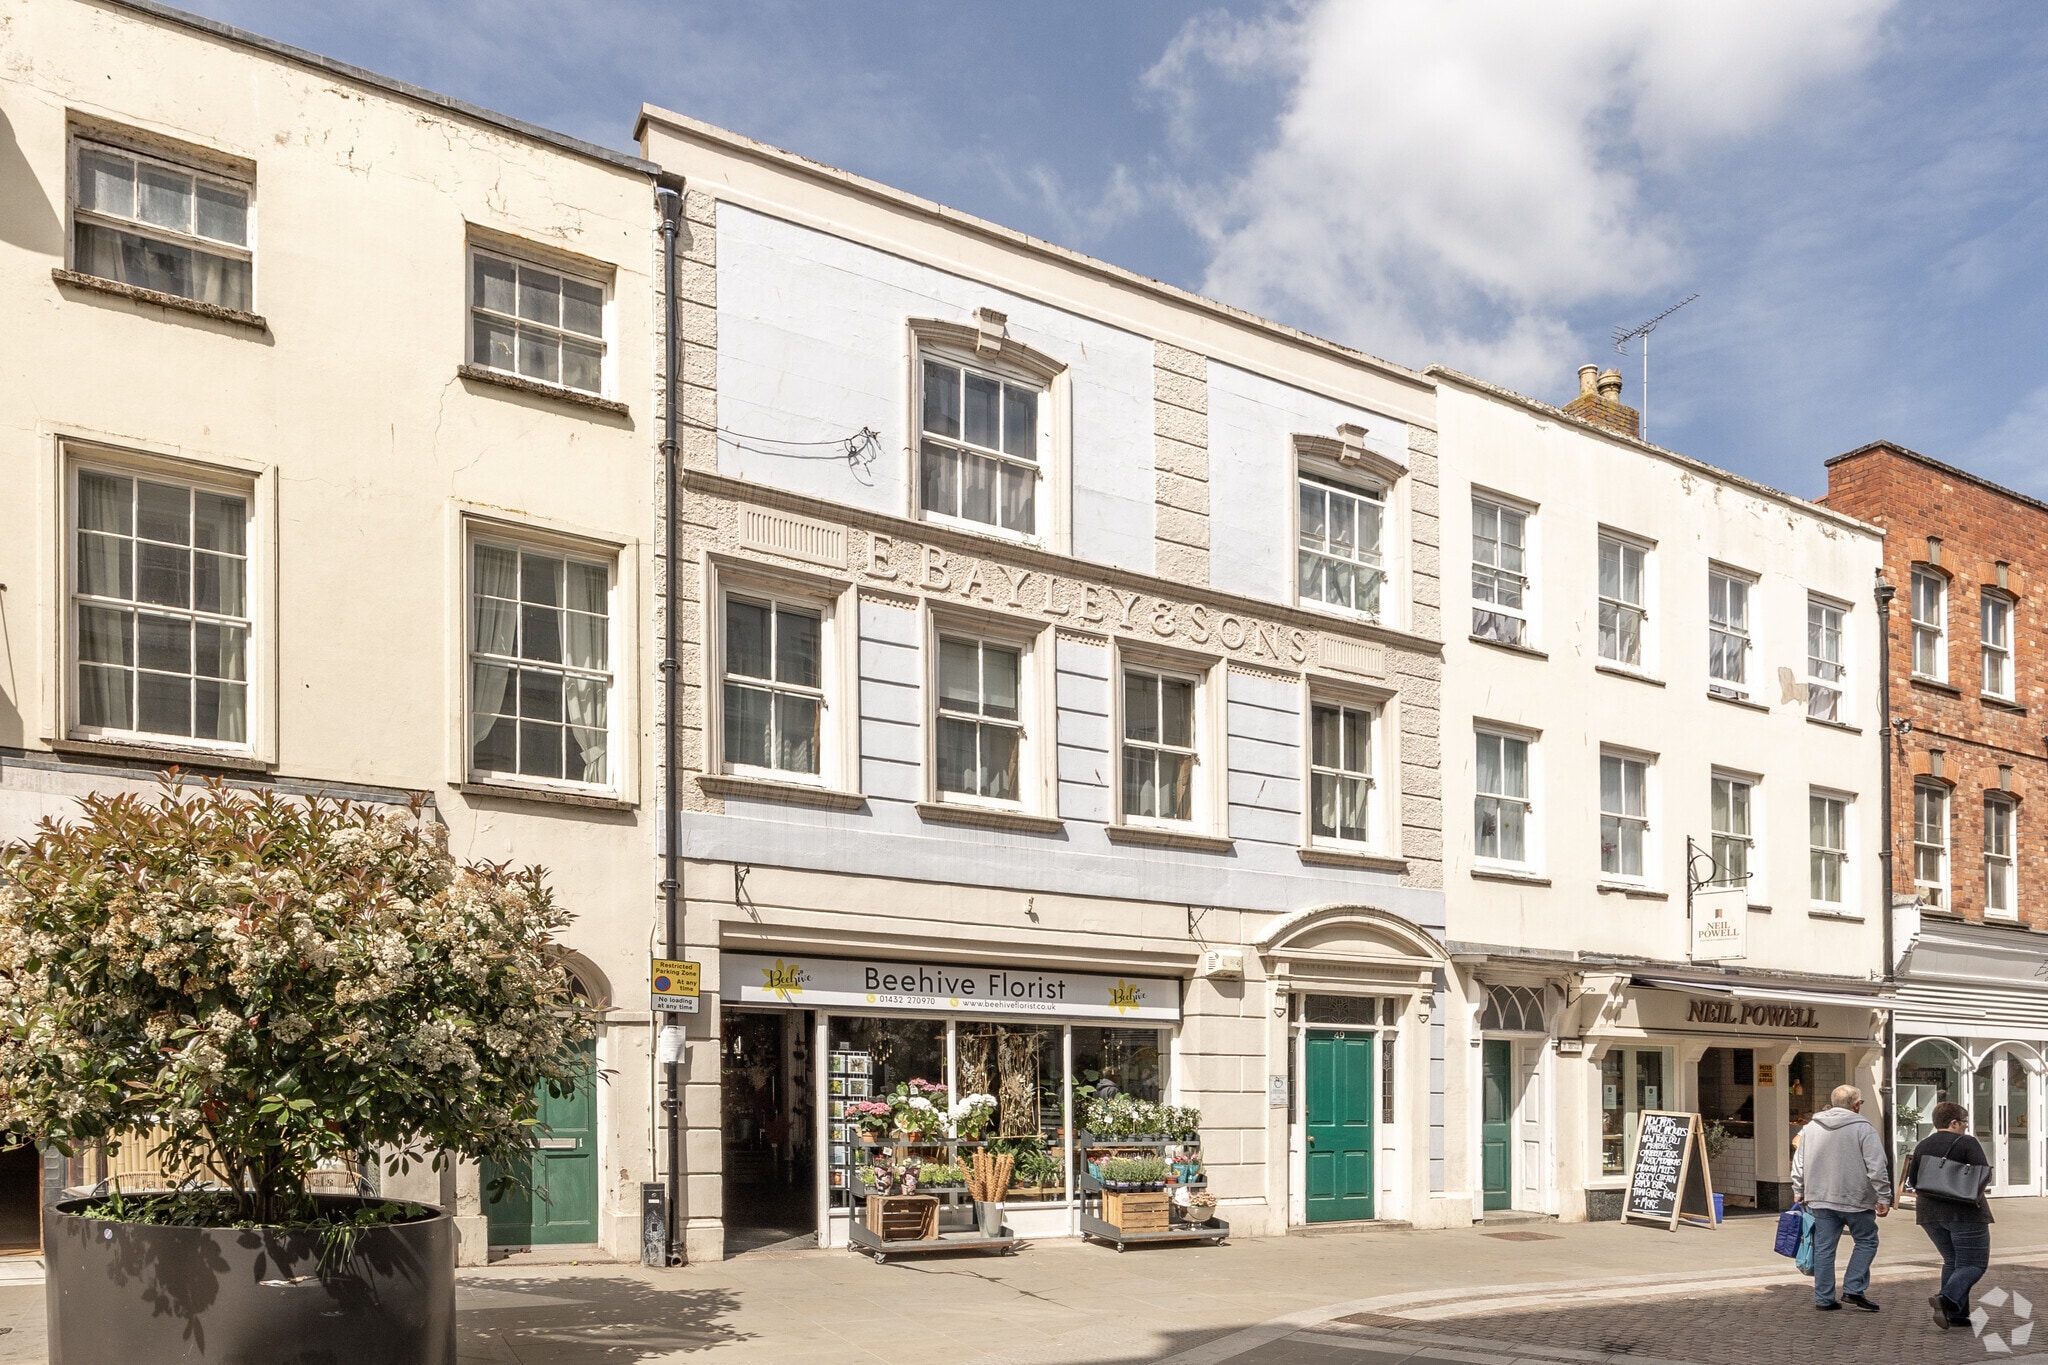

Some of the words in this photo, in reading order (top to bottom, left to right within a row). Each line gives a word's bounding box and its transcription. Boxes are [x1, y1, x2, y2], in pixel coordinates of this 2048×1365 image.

[1706, 922, 1730, 930] NEIL
[1698, 928, 1740, 938] POWELL
[660, 962, 692, 970] Restricted
[656, 968, 680, 976] Parking
[769, 968, 814, 988] Beehive
[865, 966, 976, 996] Beehive
[989, 972, 1066, 1000] Florist
[880, 994, 904, 1003] 01432
[906, 996, 936, 1005] 270970
[1113, 987, 1148, 1005] Beehive
[962, 1000, 1056, 1011] www.beehiveflorist.co.uk
[1687, 1000, 1738, 1024] NEIL
[1739, 1002, 1819, 1029] POWELL
[1333, 1031, 1345, 1039] 49
[1640, 1198, 1660, 1209] MORE
